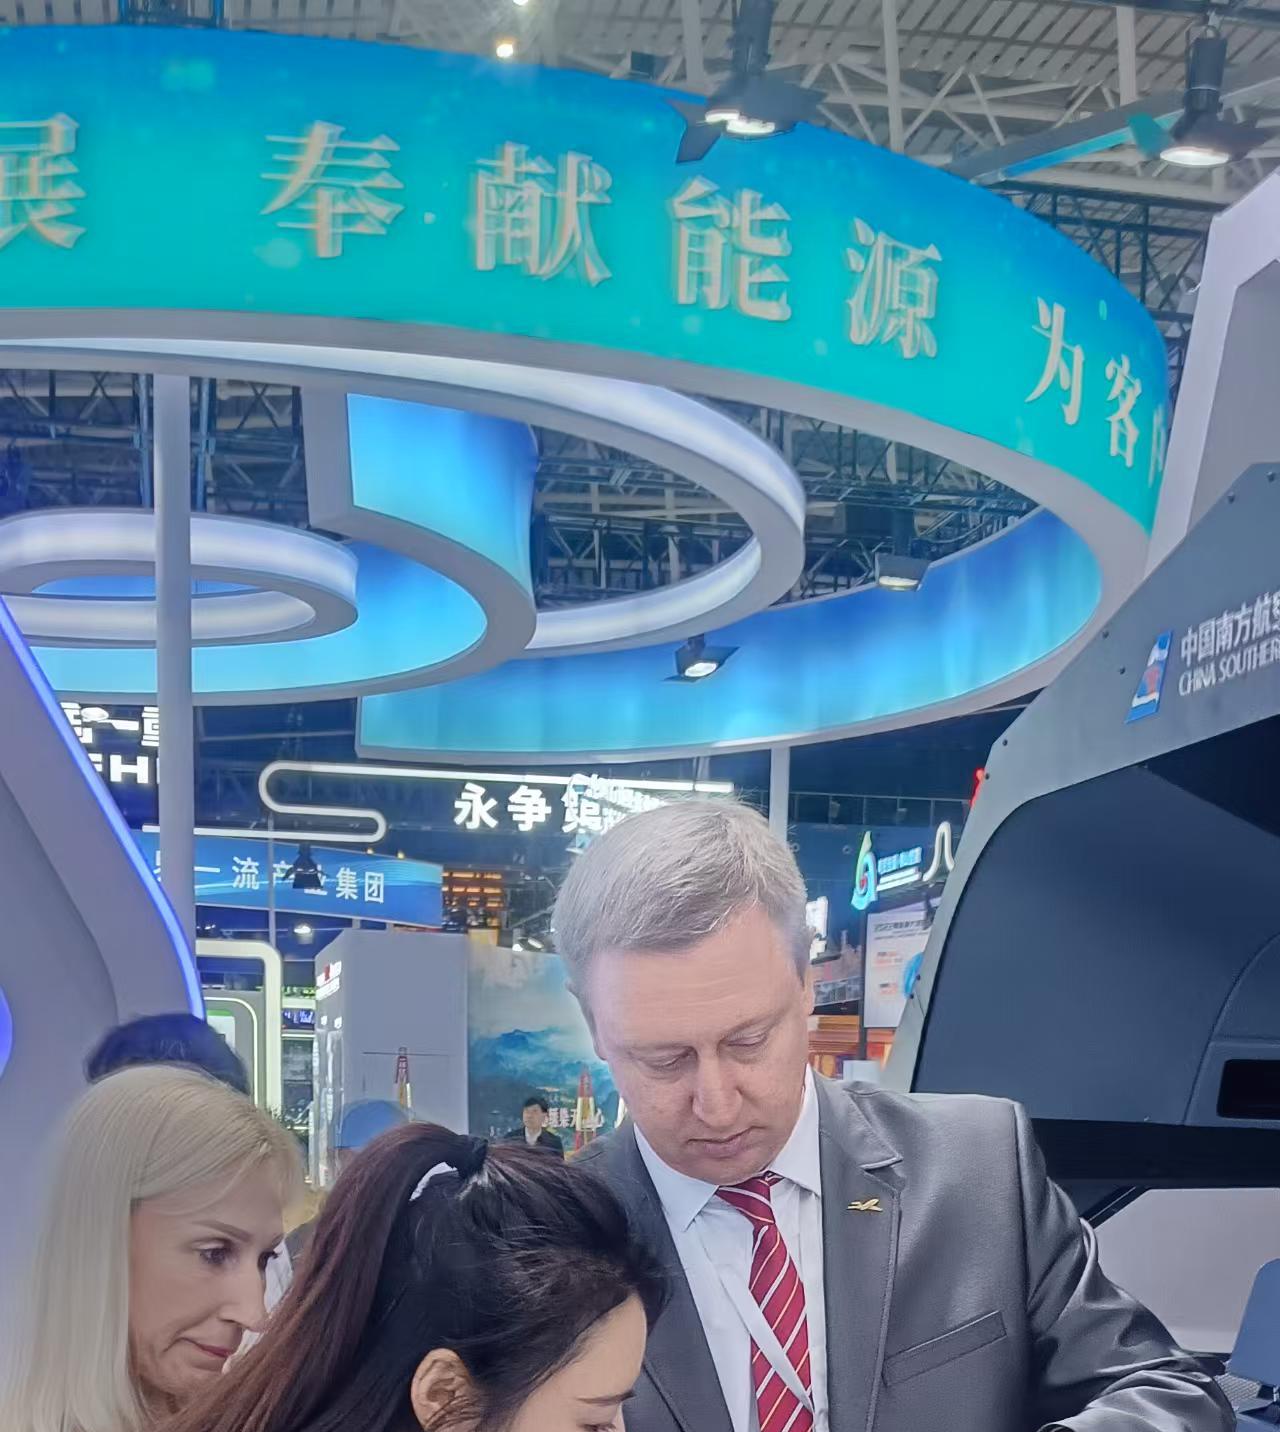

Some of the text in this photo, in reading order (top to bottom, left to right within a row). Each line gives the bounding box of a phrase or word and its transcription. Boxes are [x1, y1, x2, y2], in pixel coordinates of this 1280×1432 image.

[259, 119, 943, 359] 奉献能源
[1178, 660, 1217, 696] CHINA
[154, 850, 385, 905] 一流产集团
